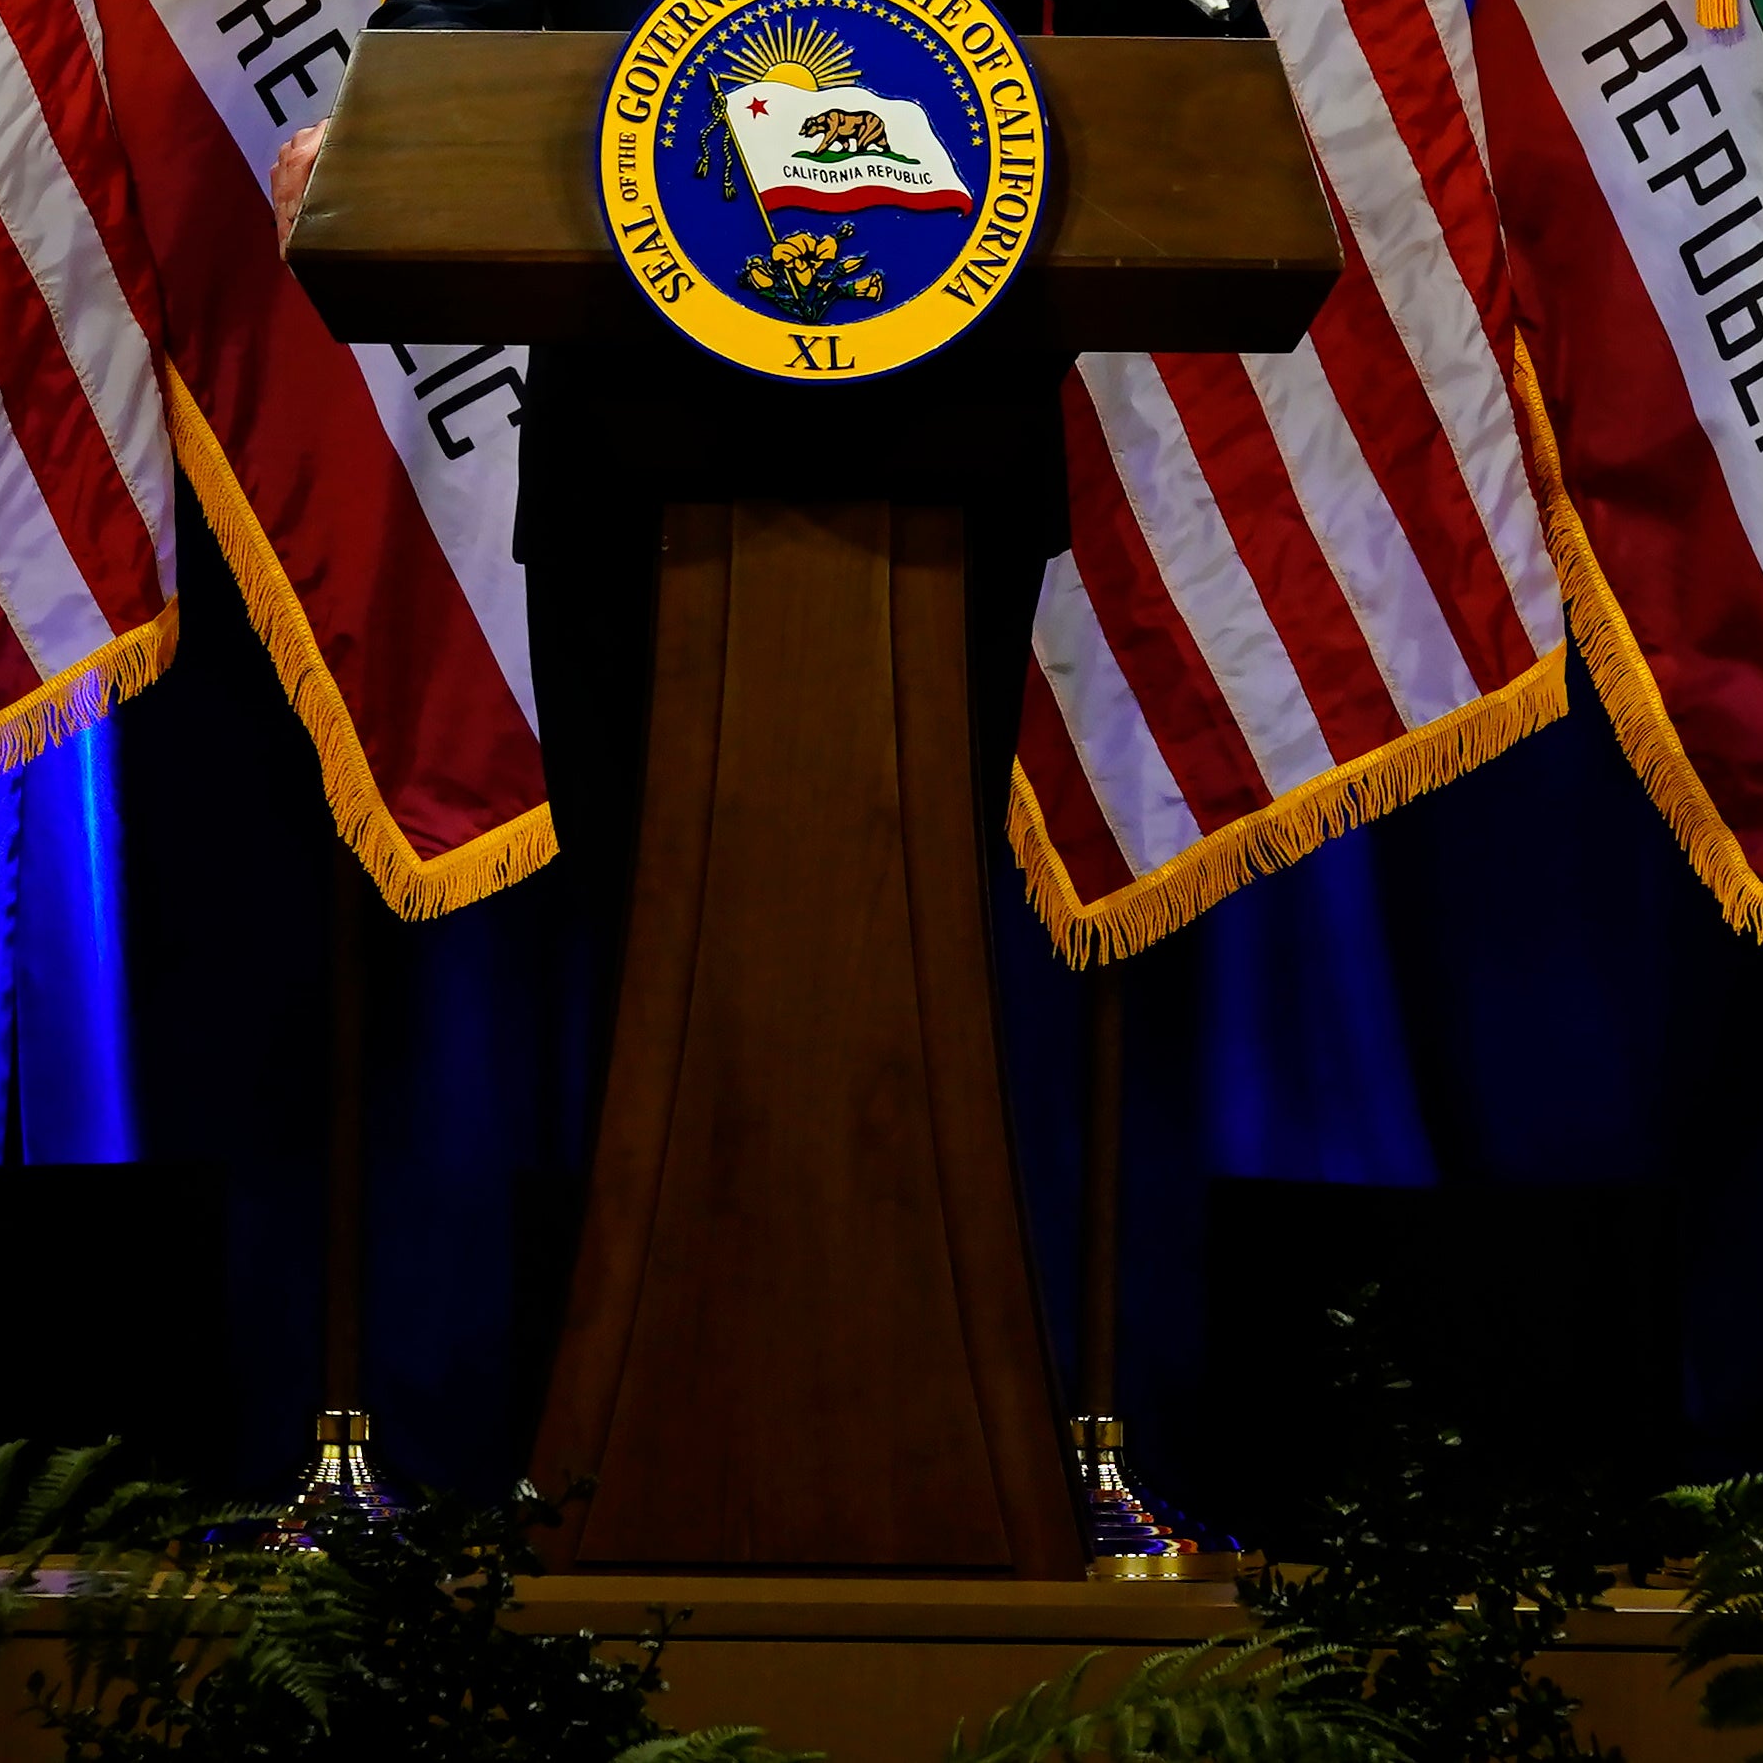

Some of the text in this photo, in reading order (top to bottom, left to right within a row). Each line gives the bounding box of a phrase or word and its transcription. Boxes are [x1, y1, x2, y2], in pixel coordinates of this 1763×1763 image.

[961, 22, 1014, 73] OF
[618, 131, 637, 174] THE
[619, 176, 639, 202] OF
[783, 165, 933, 185] CALIFORNIA REPUBLIC
[941, 78, 1036, 307] CALIFORNIA
[621, 205, 695, 304] SEAL
[784, 333, 856, 371] XL
